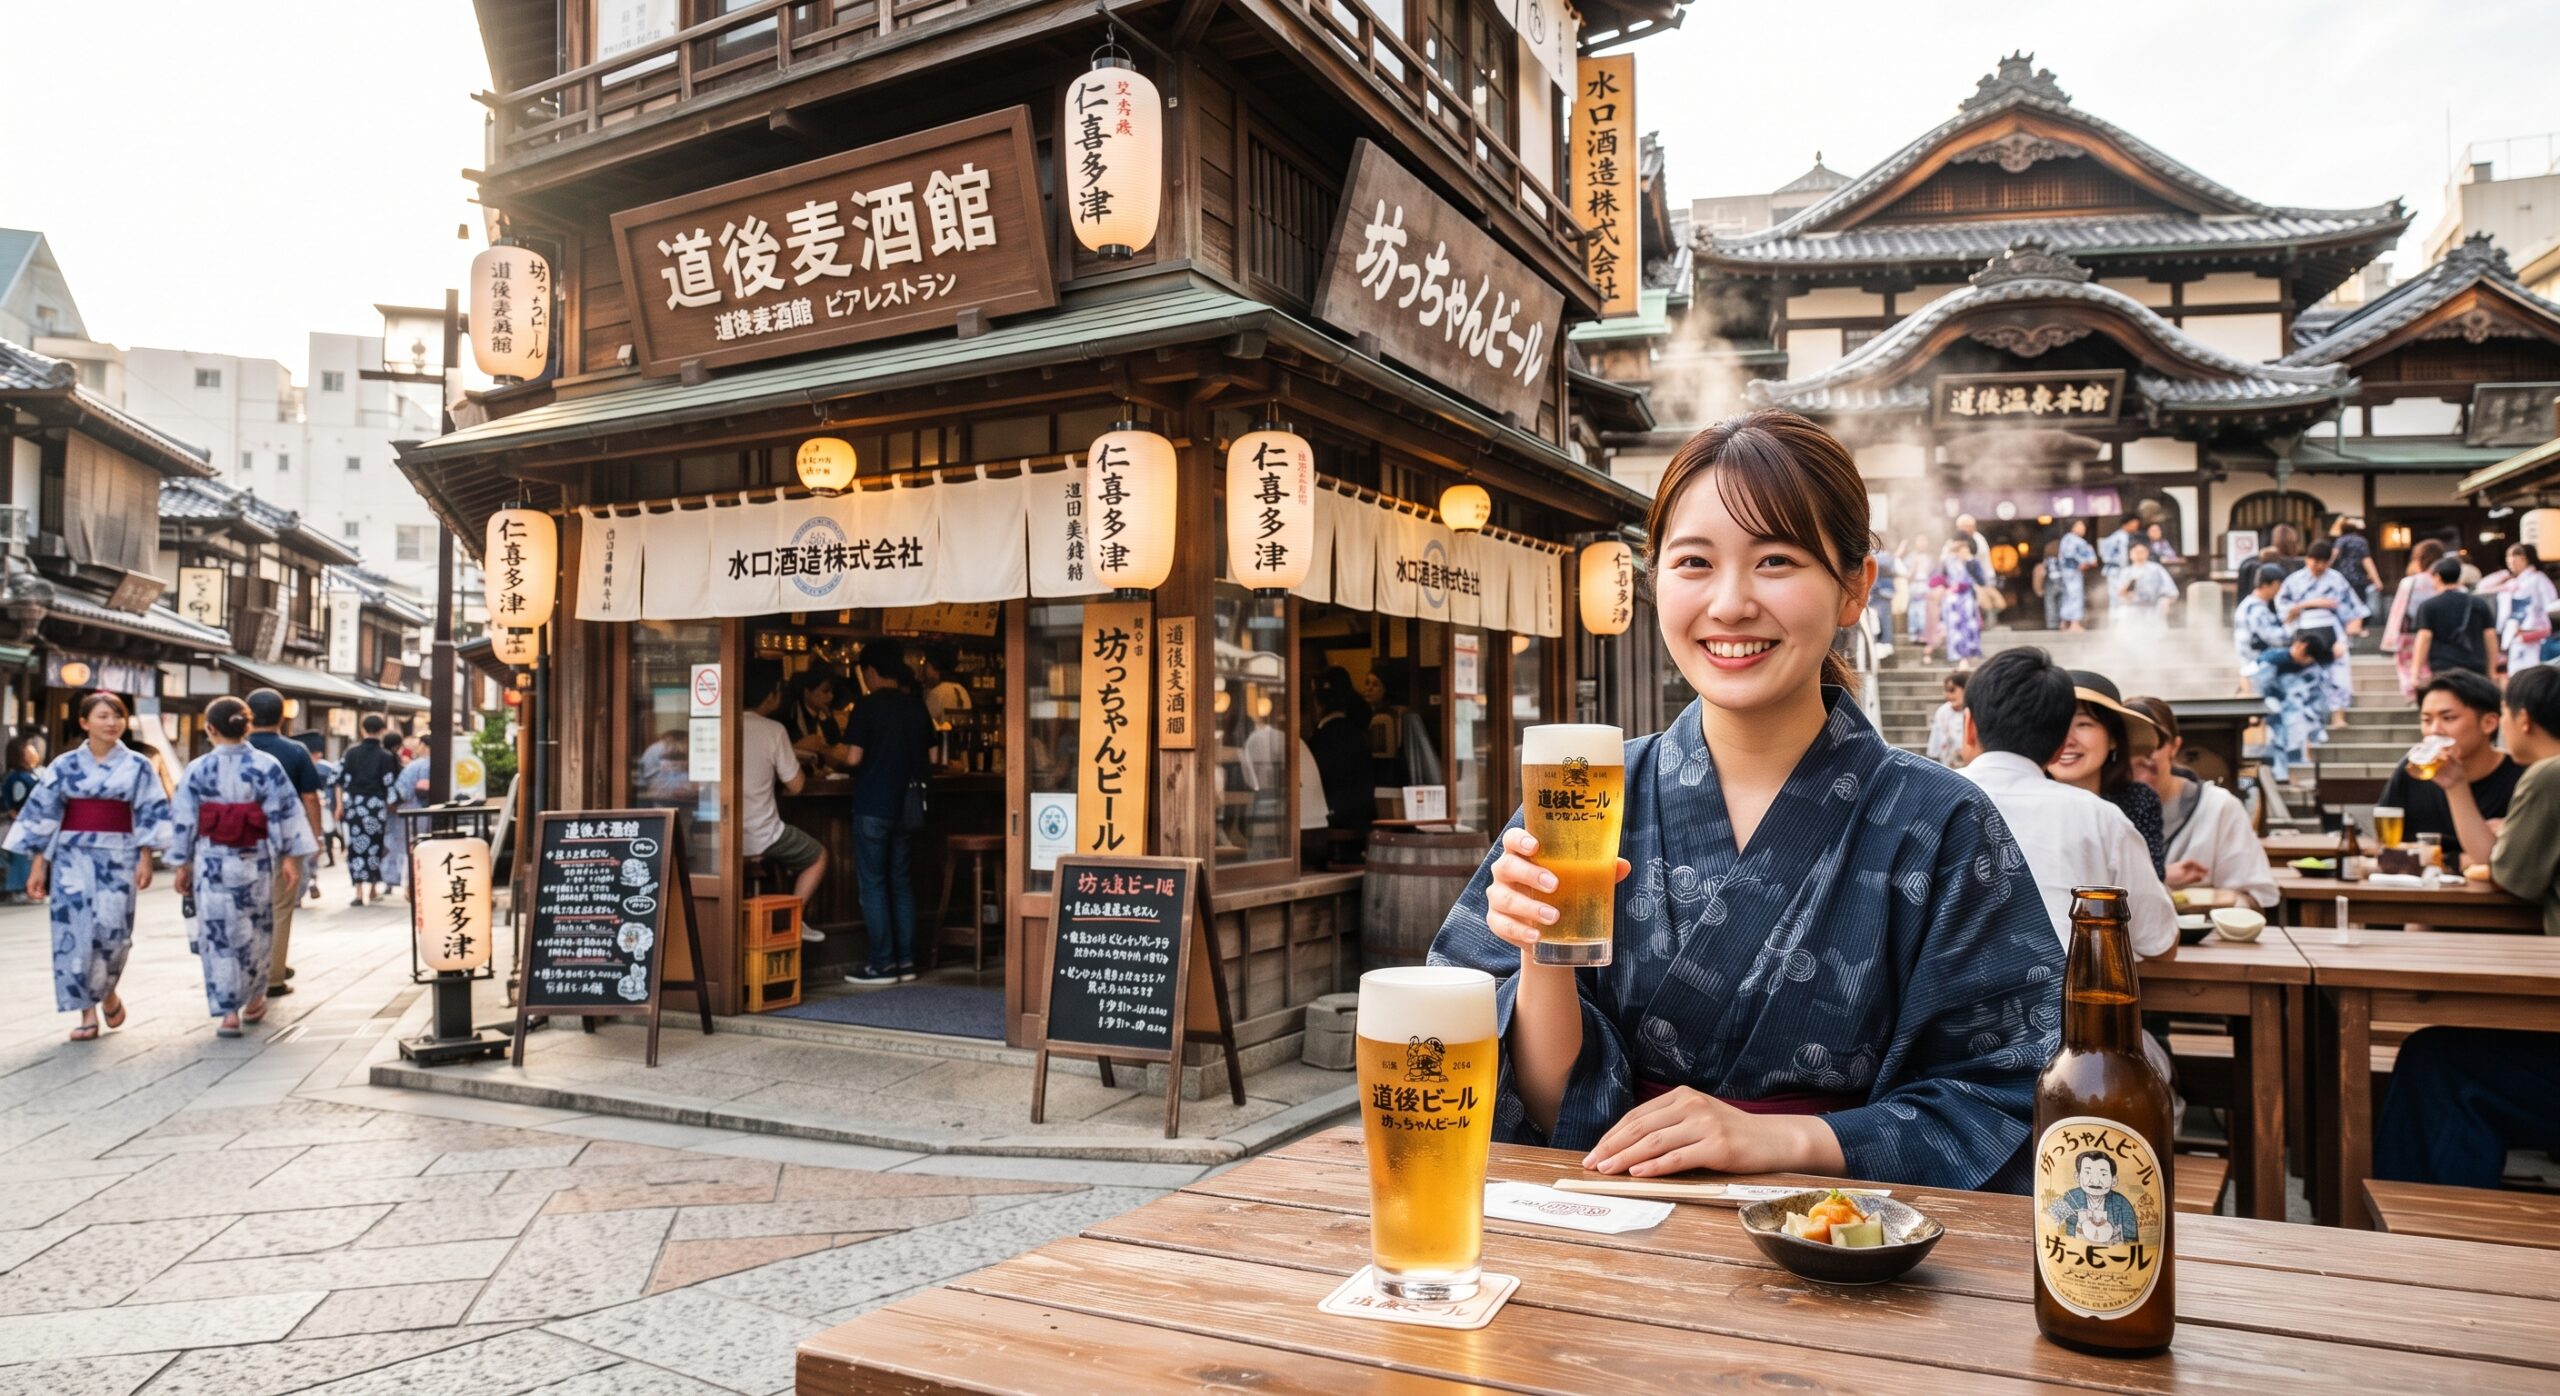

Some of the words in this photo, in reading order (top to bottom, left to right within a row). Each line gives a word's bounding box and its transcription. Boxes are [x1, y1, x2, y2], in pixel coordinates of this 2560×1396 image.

[1074, 82, 1114, 225] 仁喜多津
[1586, 70, 1620, 300] 水口酒造株式会社
[657, 162, 997, 311] 道後麦酒館
[714, 297, 814, 341] 道後麦酒館
[825, 273, 956, 318] ビアレストラン
[1356, 199, 1543, 387] 坊っちゃんビール
[1950, 384, 2110, 416] 道後温泉本館
[1097, 443, 1131, 572] 仁喜多津
[1252, 441, 1290, 572] 仁喜多津
[498, 518, 528, 615] 仁喜多津
[728, 536, 923, 580] 水口酒造株式会社
[1396, 555, 1480, 597] 水口酒造株式会社
[1092, 627, 1130, 851] 坊っちゃんビール
[1537, 788, 1610, 809] 道後ビール
[440, 852, 476, 960] 仁喜多津
[1373, 1083, 1478, 1113] 道後ビール
[1381, 1114, 1470, 1131] 坊っちゃんビール
[2041, 1130, 2154, 1186] 坊っちゃんビール
